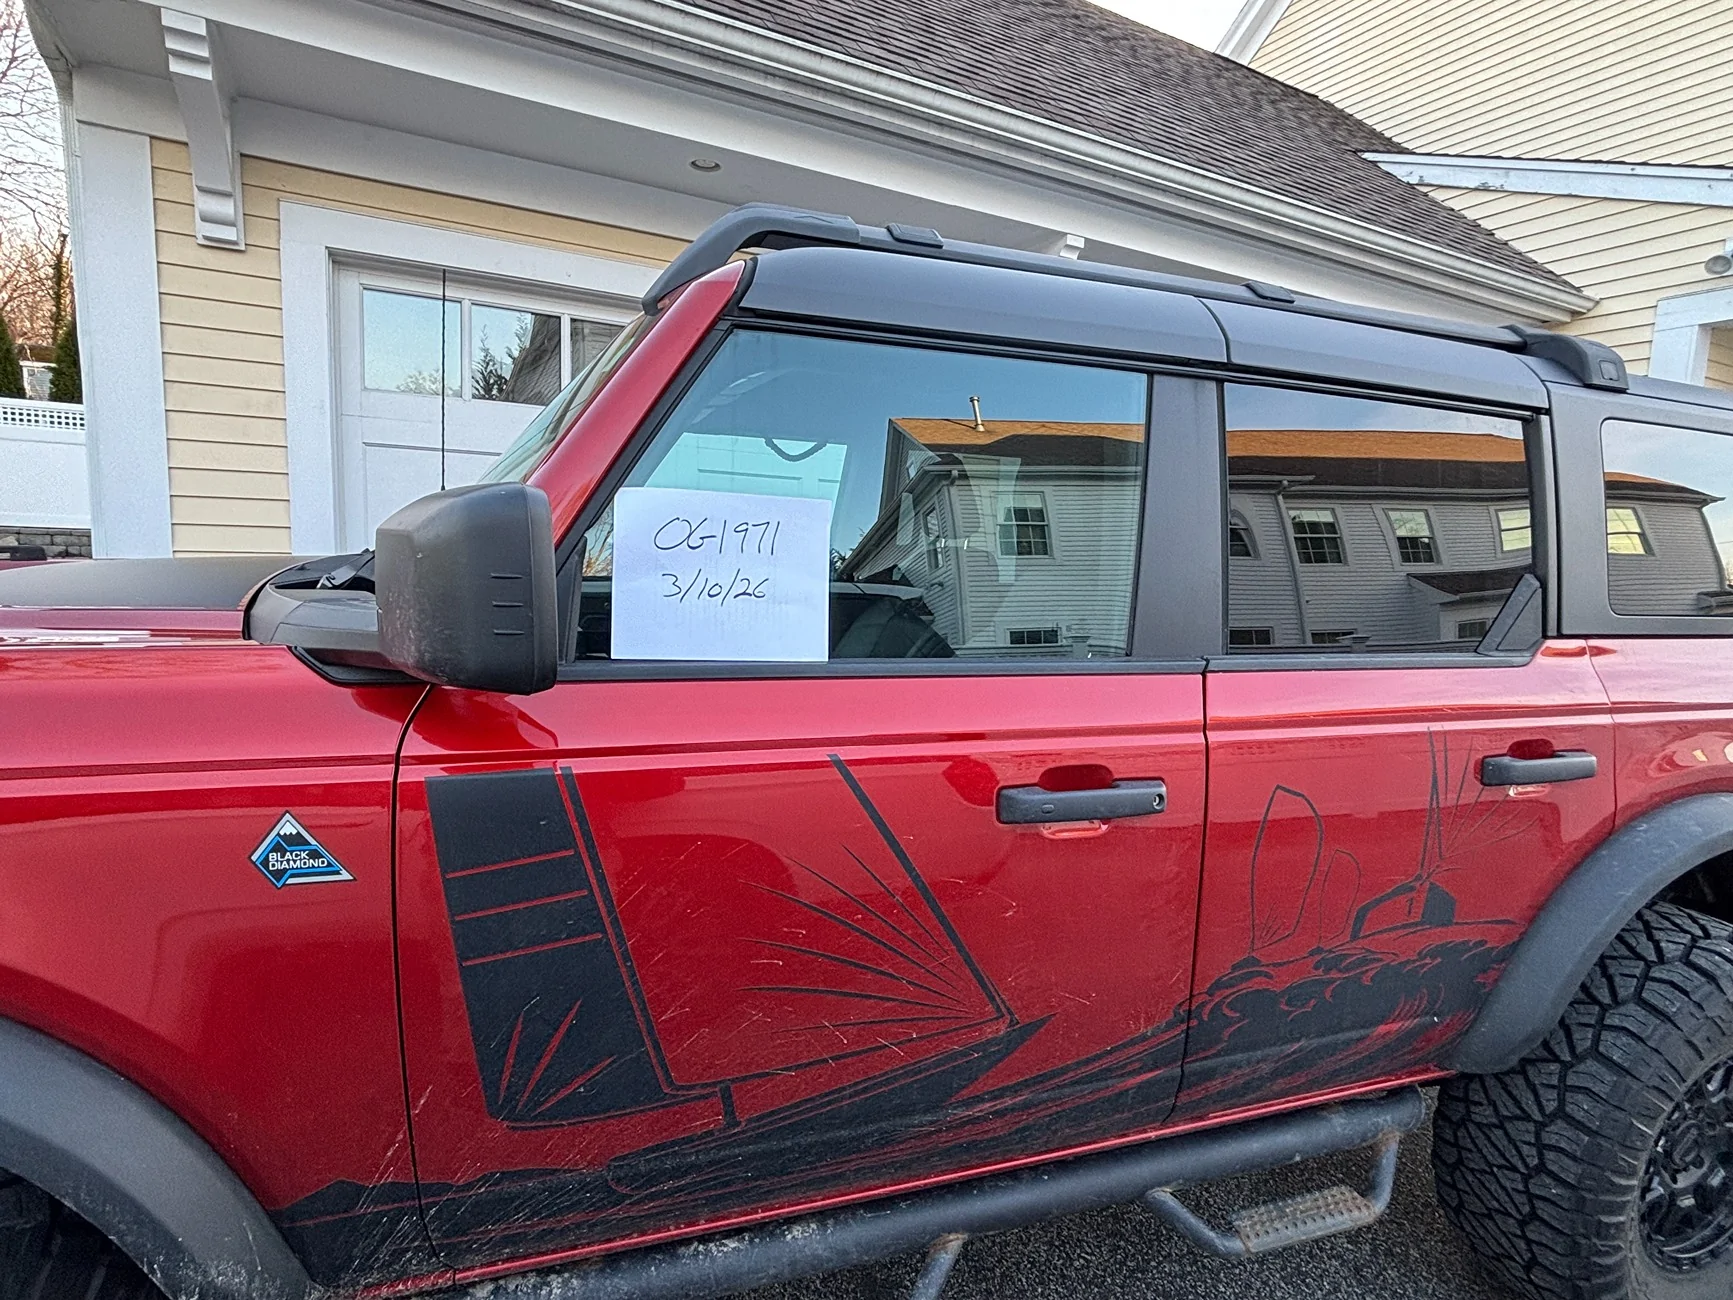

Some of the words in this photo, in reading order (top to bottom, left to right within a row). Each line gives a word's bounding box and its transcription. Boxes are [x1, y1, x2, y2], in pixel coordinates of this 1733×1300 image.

[654, 517, 780, 556] OG1971
[661, 568, 770, 606] 3/10/26
[268, 850, 309, 862] BLACK
[268, 858, 328, 871] DIAMOND
